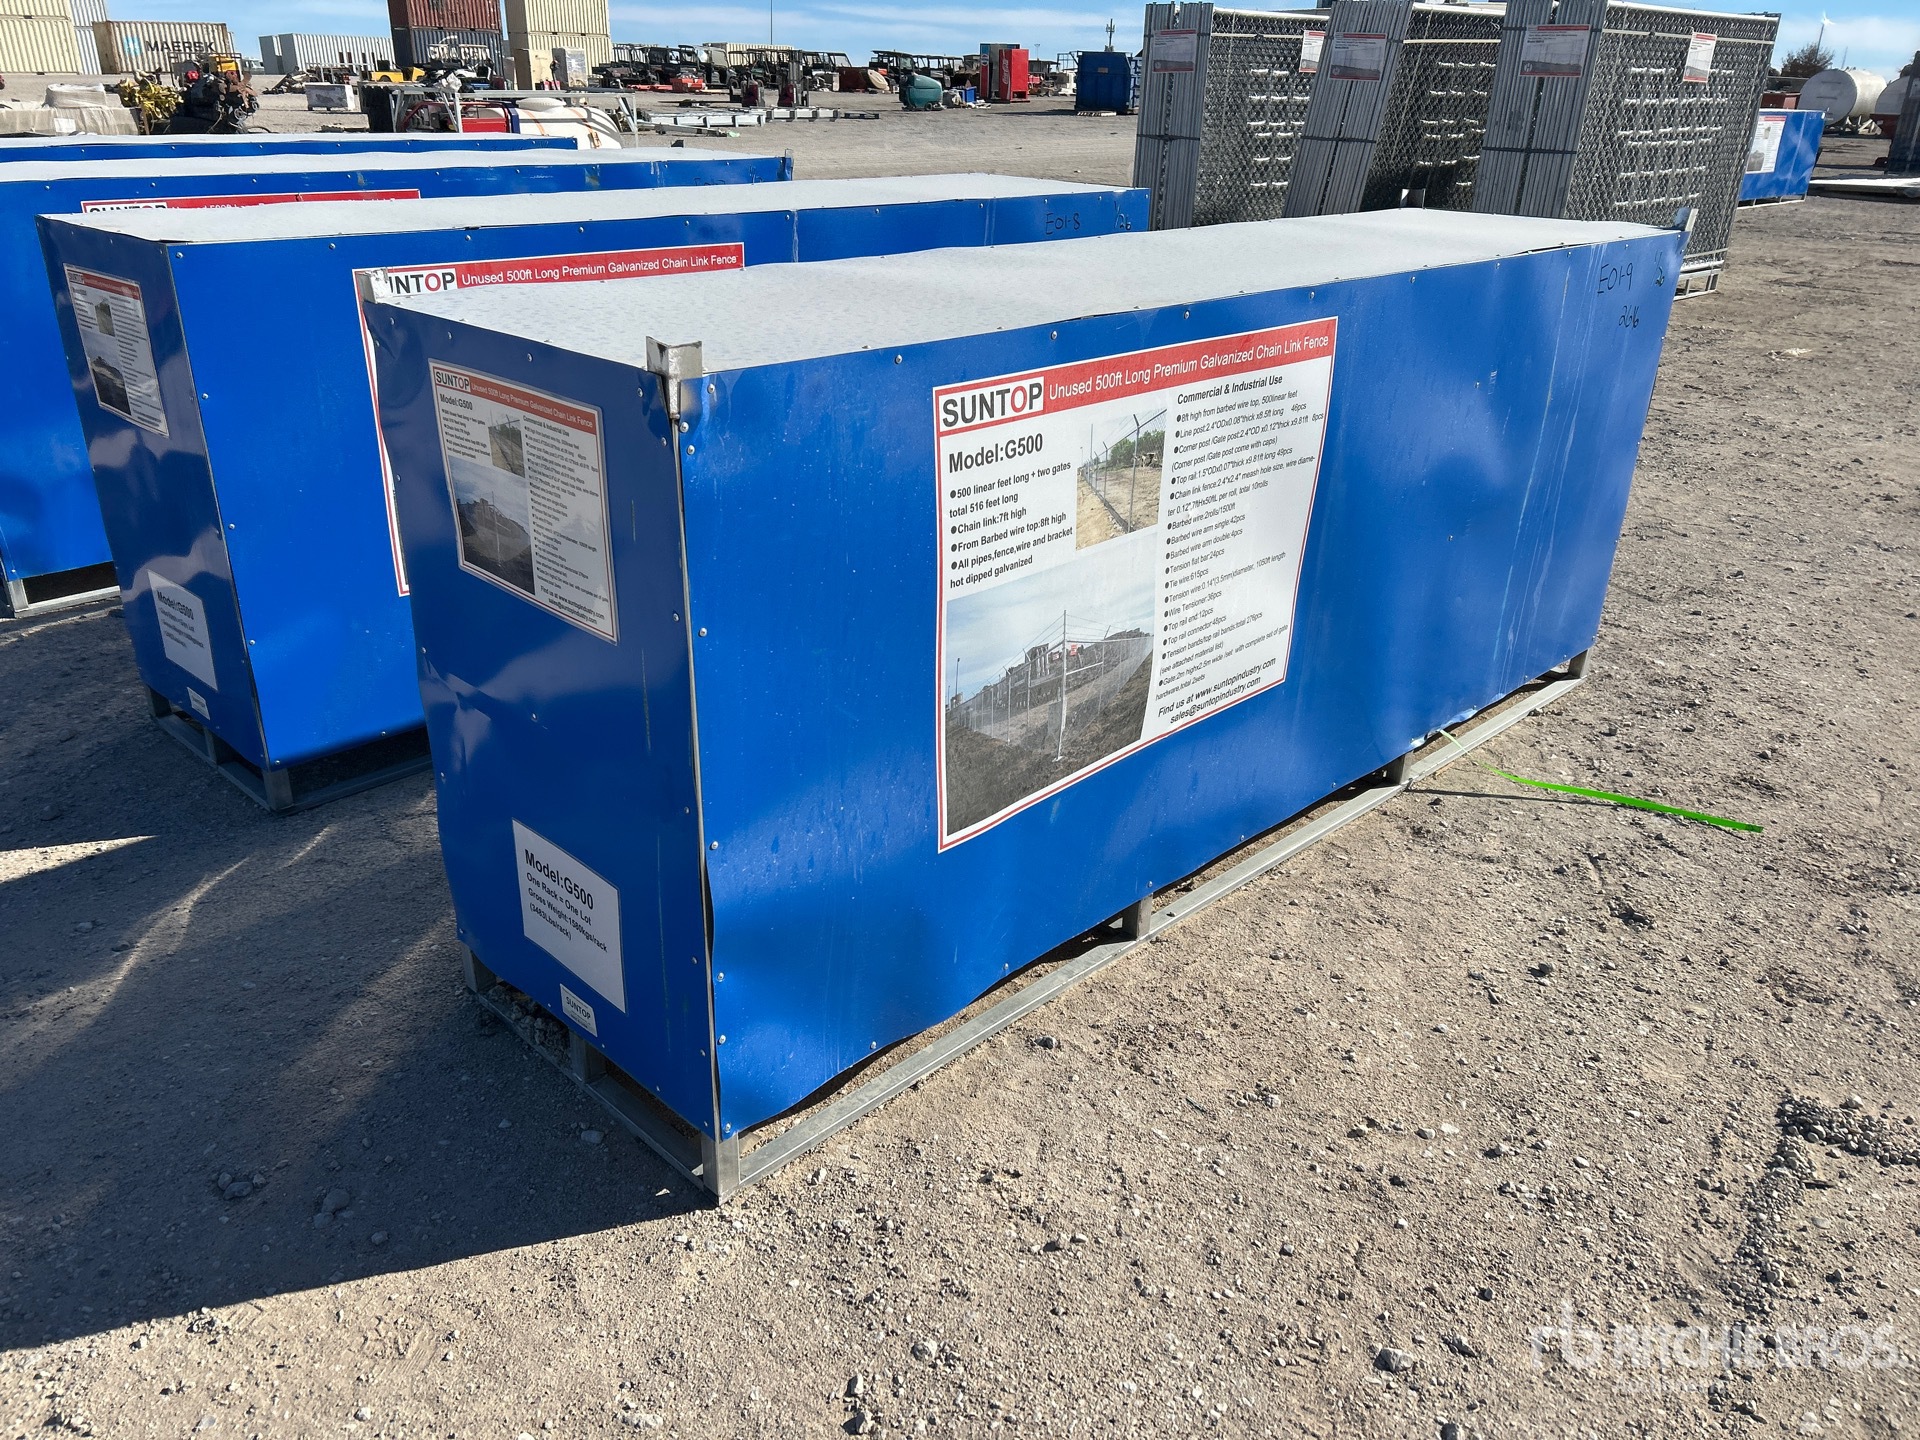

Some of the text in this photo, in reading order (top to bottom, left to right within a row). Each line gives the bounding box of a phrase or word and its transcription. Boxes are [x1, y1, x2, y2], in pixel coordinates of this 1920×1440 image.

[144, 41, 216, 52] MAERSK
[389, 254, 738, 294] NTOP Unused 500ft Long Premium Galvanized Chain Link Fence
[435, 371, 470, 390] SUNTOP
[498, 391, 510, 401] Long
[577, 416, 592, 427] Fence
[942, 335, 1328, 427] SUNTOP Unused 500ft Long Premium Galvanized Chain Link Fence
[1177, 375, 1282, 404] Commercial & Industrial Use
[439, 393, 473, 410] Model:G500
[1181, 412, 1189, 422] 8ft
[1189, 410, 1202, 421] high
[1202, 408, 1215, 416] from
[1216, 401, 1236, 414] barbed
[1236, 401, 1249, 409] wire
[1287, 389, 1297, 398] feet
[949, 432, 1042, 473] Model:G500
[957, 486, 971, 498] 500
[973, 481, 995, 494] linear
[996, 476, 1011, 488] feet
[1013, 473, 1029, 484] long
[1037, 467, 1050, 477] two
[1051, 462, 1071, 475] gates
[949, 493, 1018, 518] total 516 feet long
[957, 506, 1026, 533] Chain link:7ft high
[957, 511, 1066, 552] From Barbed wire top:8ft high
[957, 526, 1072, 569] All pipes,fence,wire and bracket
[950, 554, 1032, 588] hot dipped galvanized
[1195, 657, 1276, 699] www.suntopindustry.com
[1170, 676, 1260, 723] sales@suntopindustry.com
[525, 849, 594, 910] Model:G500
[528, 887, 547, 906] Gross
[527, 872, 541, 888] One
[541, 882, 559, 901] Rack
[565, 899, 579, 916] One
[580, 910, 592, 926] Lot
[566, 996, 591, 1019] SUNTOP
